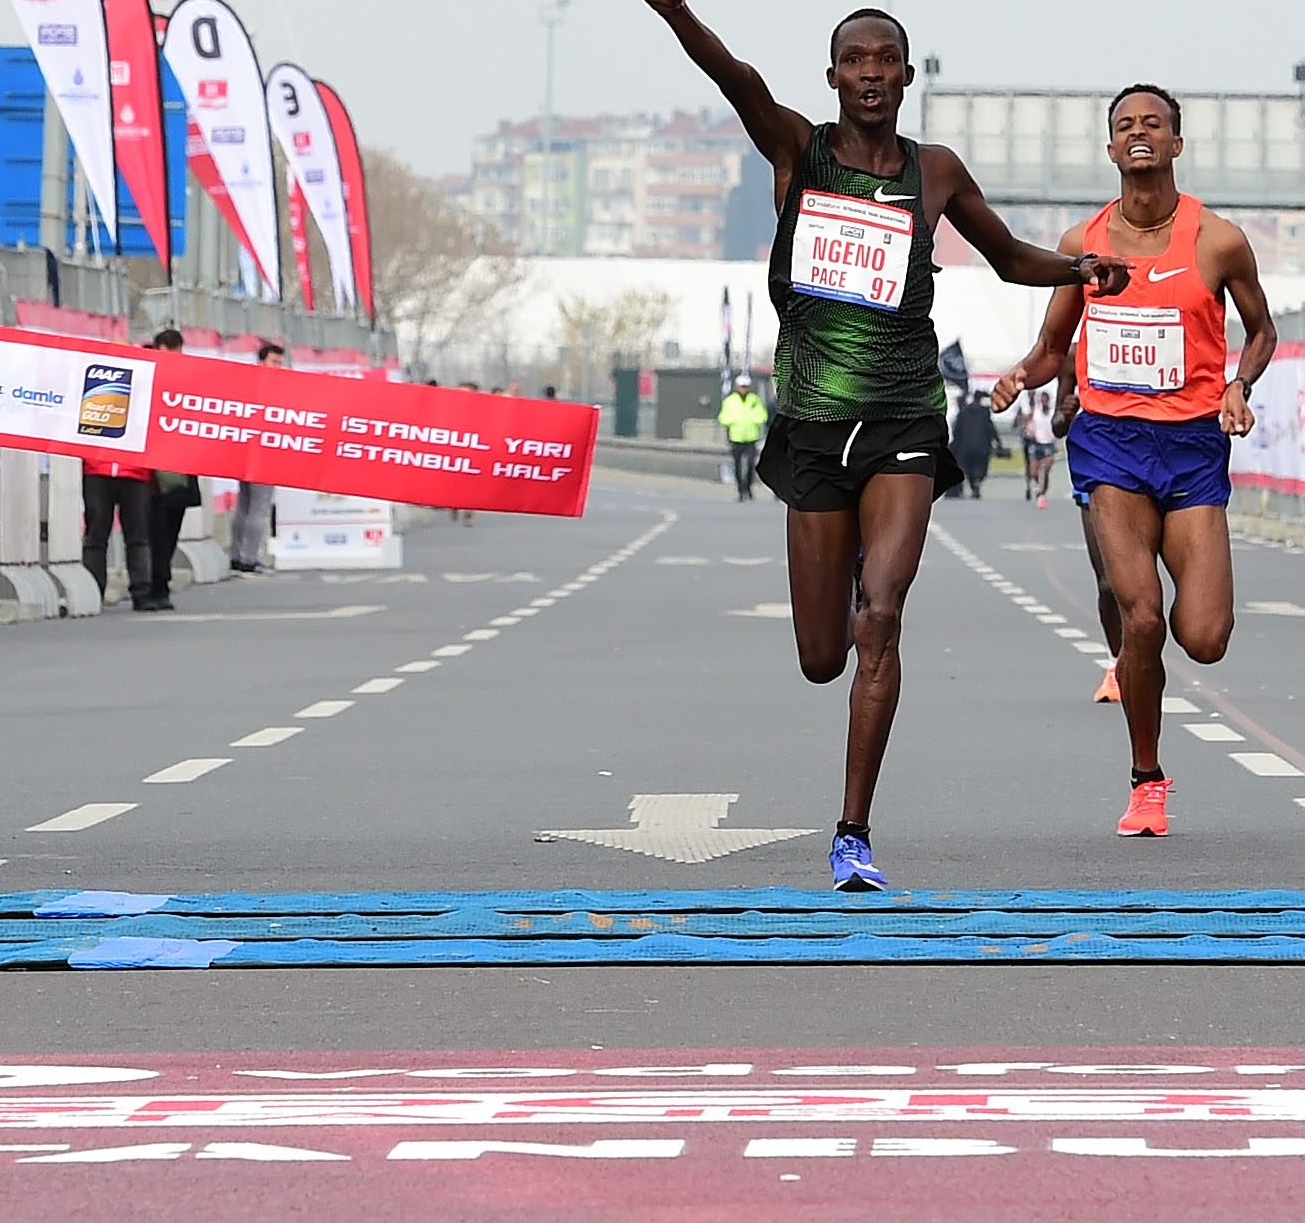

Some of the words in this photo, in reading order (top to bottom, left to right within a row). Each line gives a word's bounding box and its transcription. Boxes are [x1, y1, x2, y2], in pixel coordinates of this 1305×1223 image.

[812, 236, 886, 271] NGENO
[811, 266, 848, 287] PACE
[870, 277, 897, 303] 97
[1110, 343, 1156, 365] DEGU
[88, 368, 125, 381] IAAF
[1158, 367, 1179, 387] 14
[12, 386, 65, 404] damla
[161, 391, 327, 428] VODAFONE
[504, 437, 573, 459] YARI
[158, 416, 324, 454] VODAFONE
[492, 462, 573, 482] HALF
